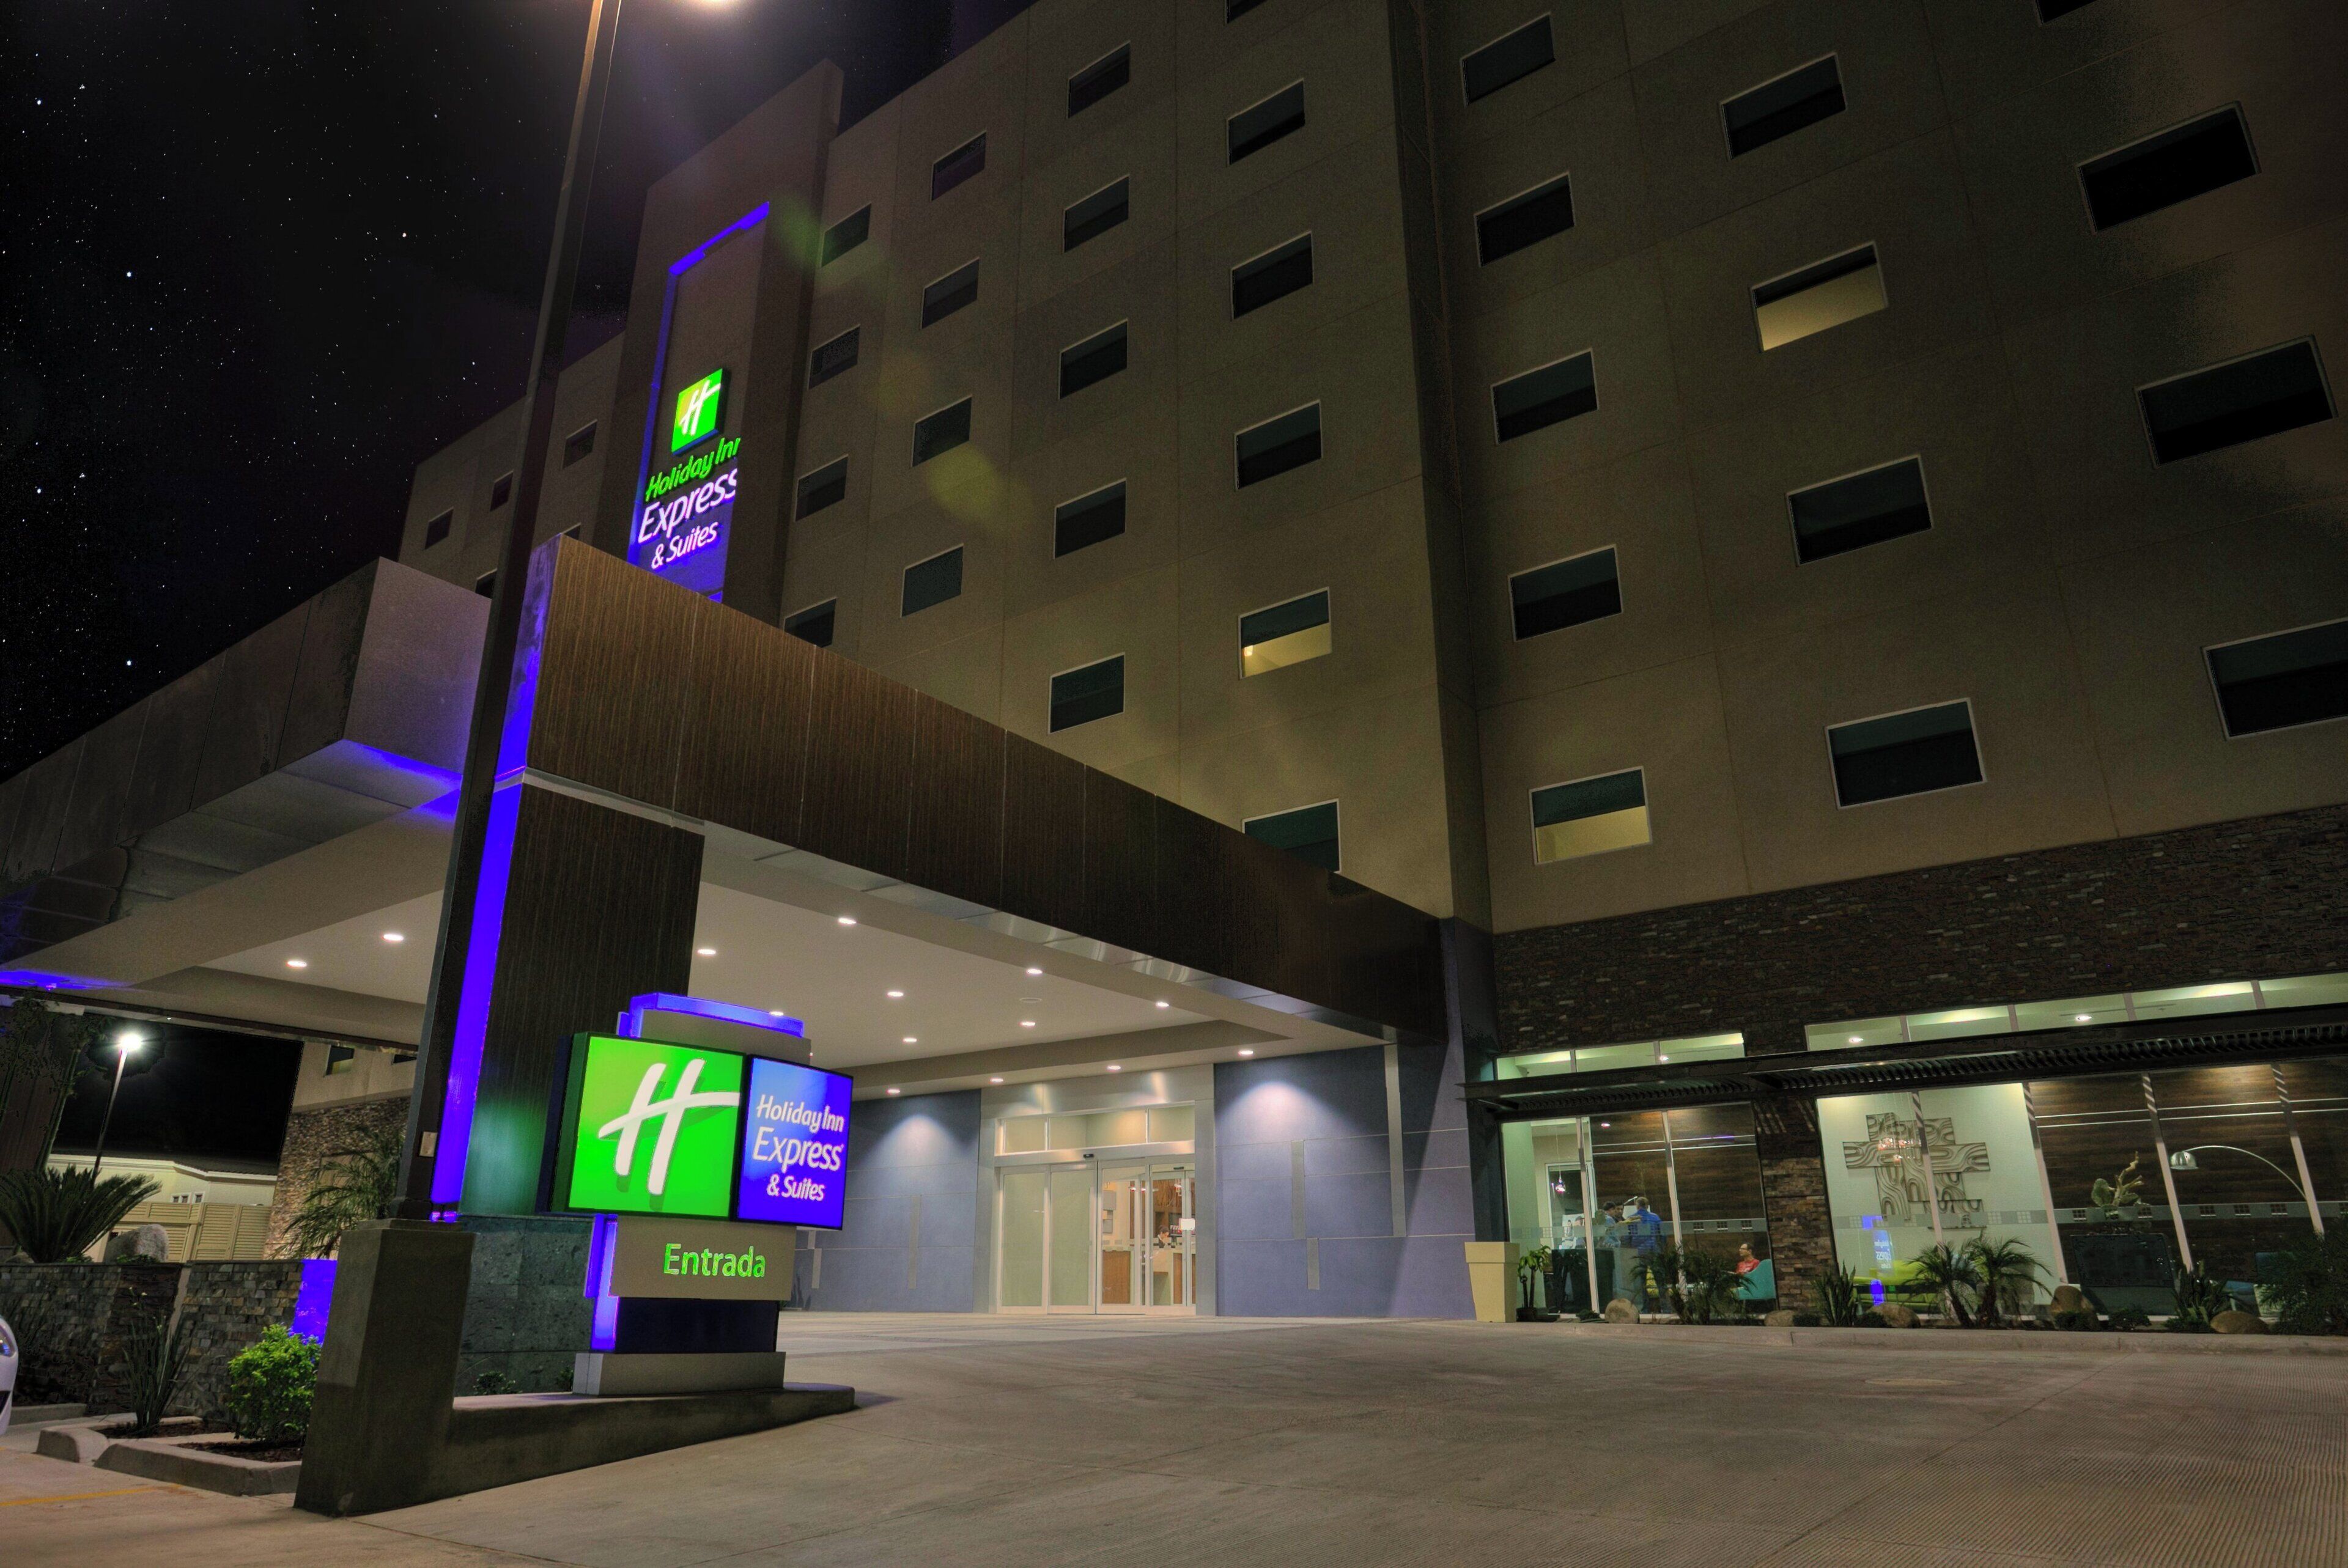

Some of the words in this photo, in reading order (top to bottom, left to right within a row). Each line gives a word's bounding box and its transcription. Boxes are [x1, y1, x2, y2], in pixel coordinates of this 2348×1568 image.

[646, 451, 715, 502] Holiday
[638, 468, 737, 543] Express
[651, 543, 665, 570] &
[666, 521, 718, 563] Suites
[756, 1094, 823, 1133] Holiday
[822, 1105, 844, 1133] Inn
[753, 1126, 843, 1174] Express
[766, 1174, 780, 1196] &
[781, 1176, 825, 1202] Suites
[663, 1243, 766, 1278] Entrada
